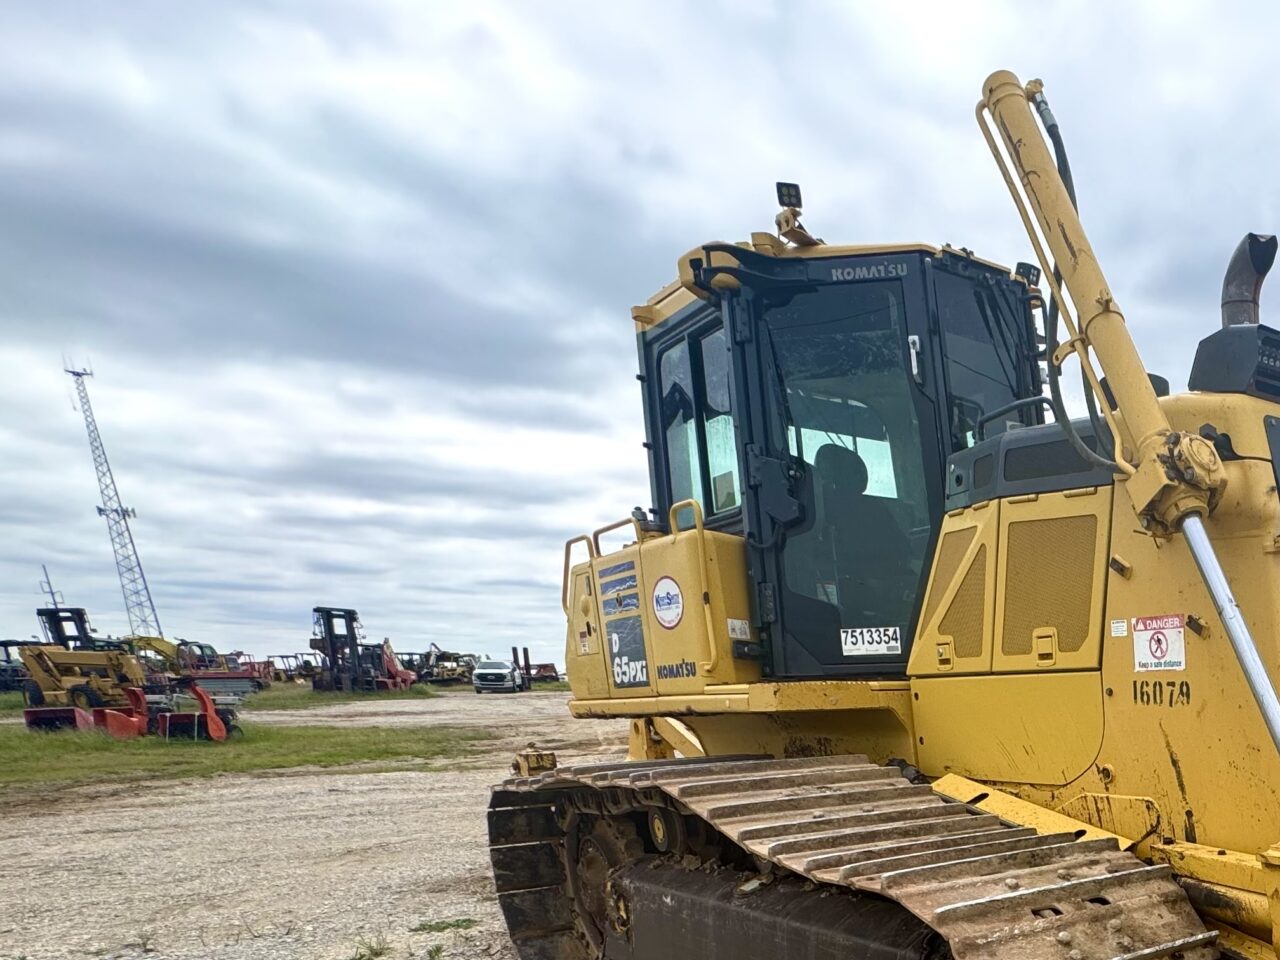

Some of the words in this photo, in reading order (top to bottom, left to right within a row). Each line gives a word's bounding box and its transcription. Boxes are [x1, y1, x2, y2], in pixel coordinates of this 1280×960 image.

[831, 261, 908, 281] KOMATSU
[1146, 617, 1180, 630] DANGER
[611, 632, 620, 653] D
[841, 628, 899, 646] 7513354
[656, 658, 697, 680] KOMATSU
